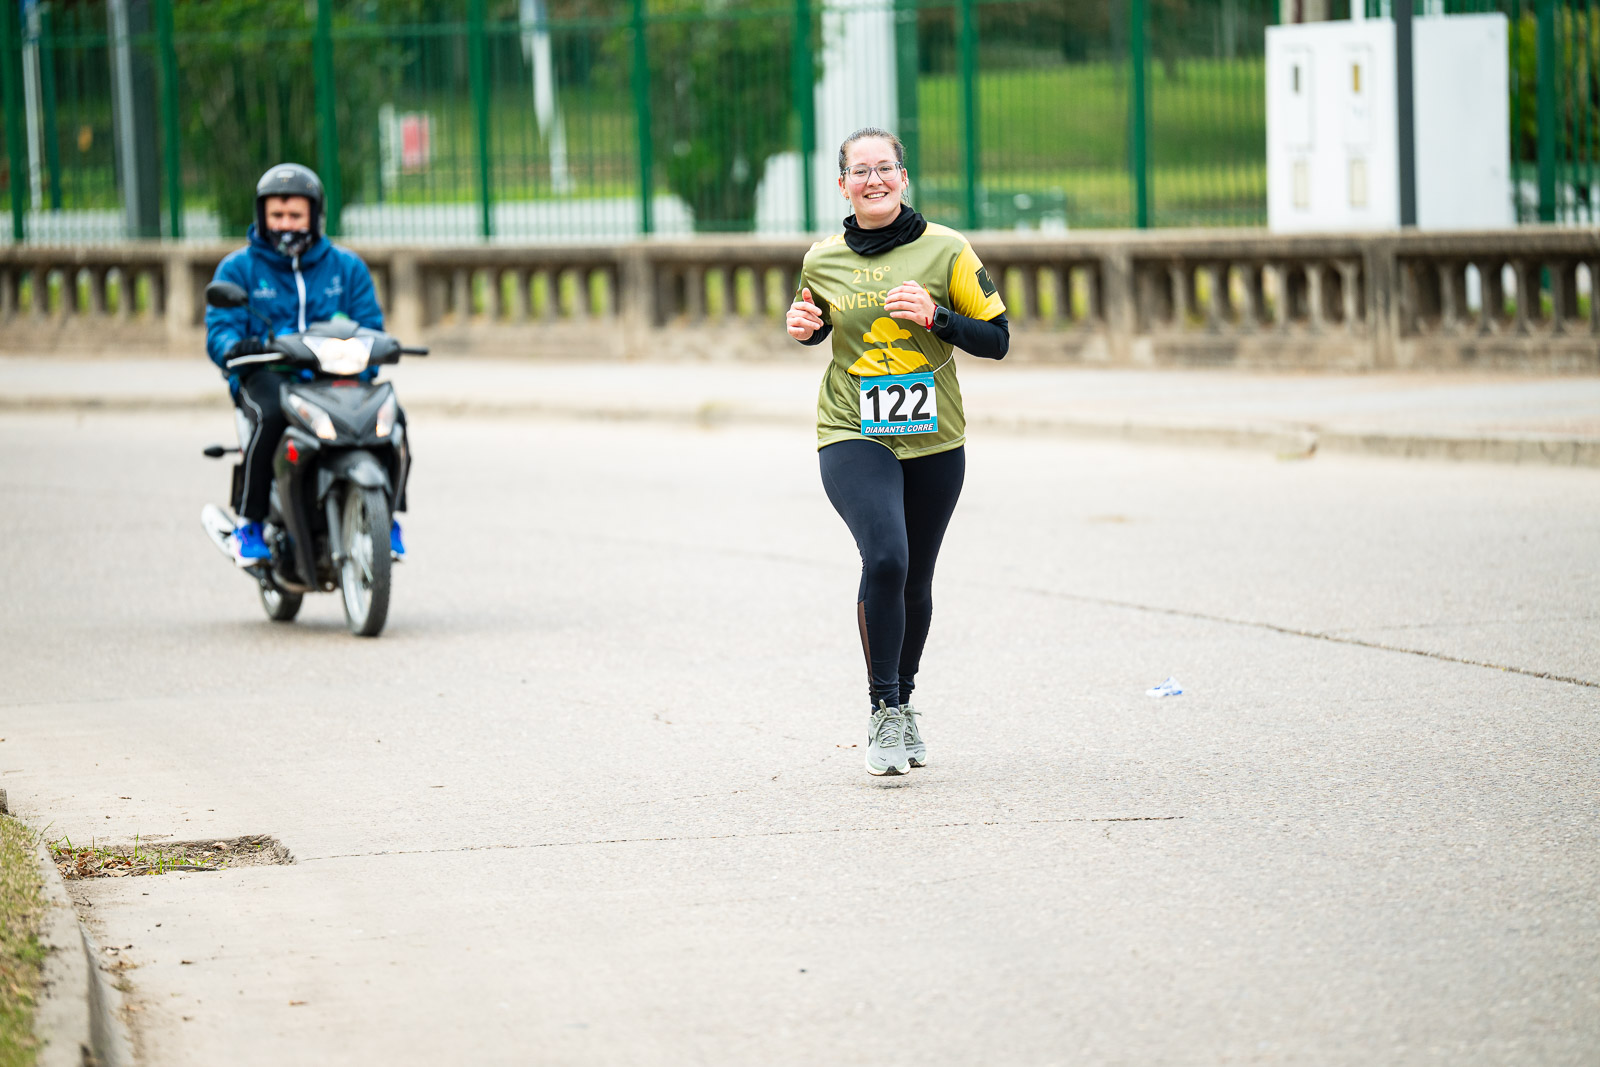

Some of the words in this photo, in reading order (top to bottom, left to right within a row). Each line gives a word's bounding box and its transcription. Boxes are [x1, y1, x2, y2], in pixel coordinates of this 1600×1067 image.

[866, 382, 930, 423] 122
[864, 426, 905, 434] DIAMANTE
[907, 423, 934, 432] CORRE
